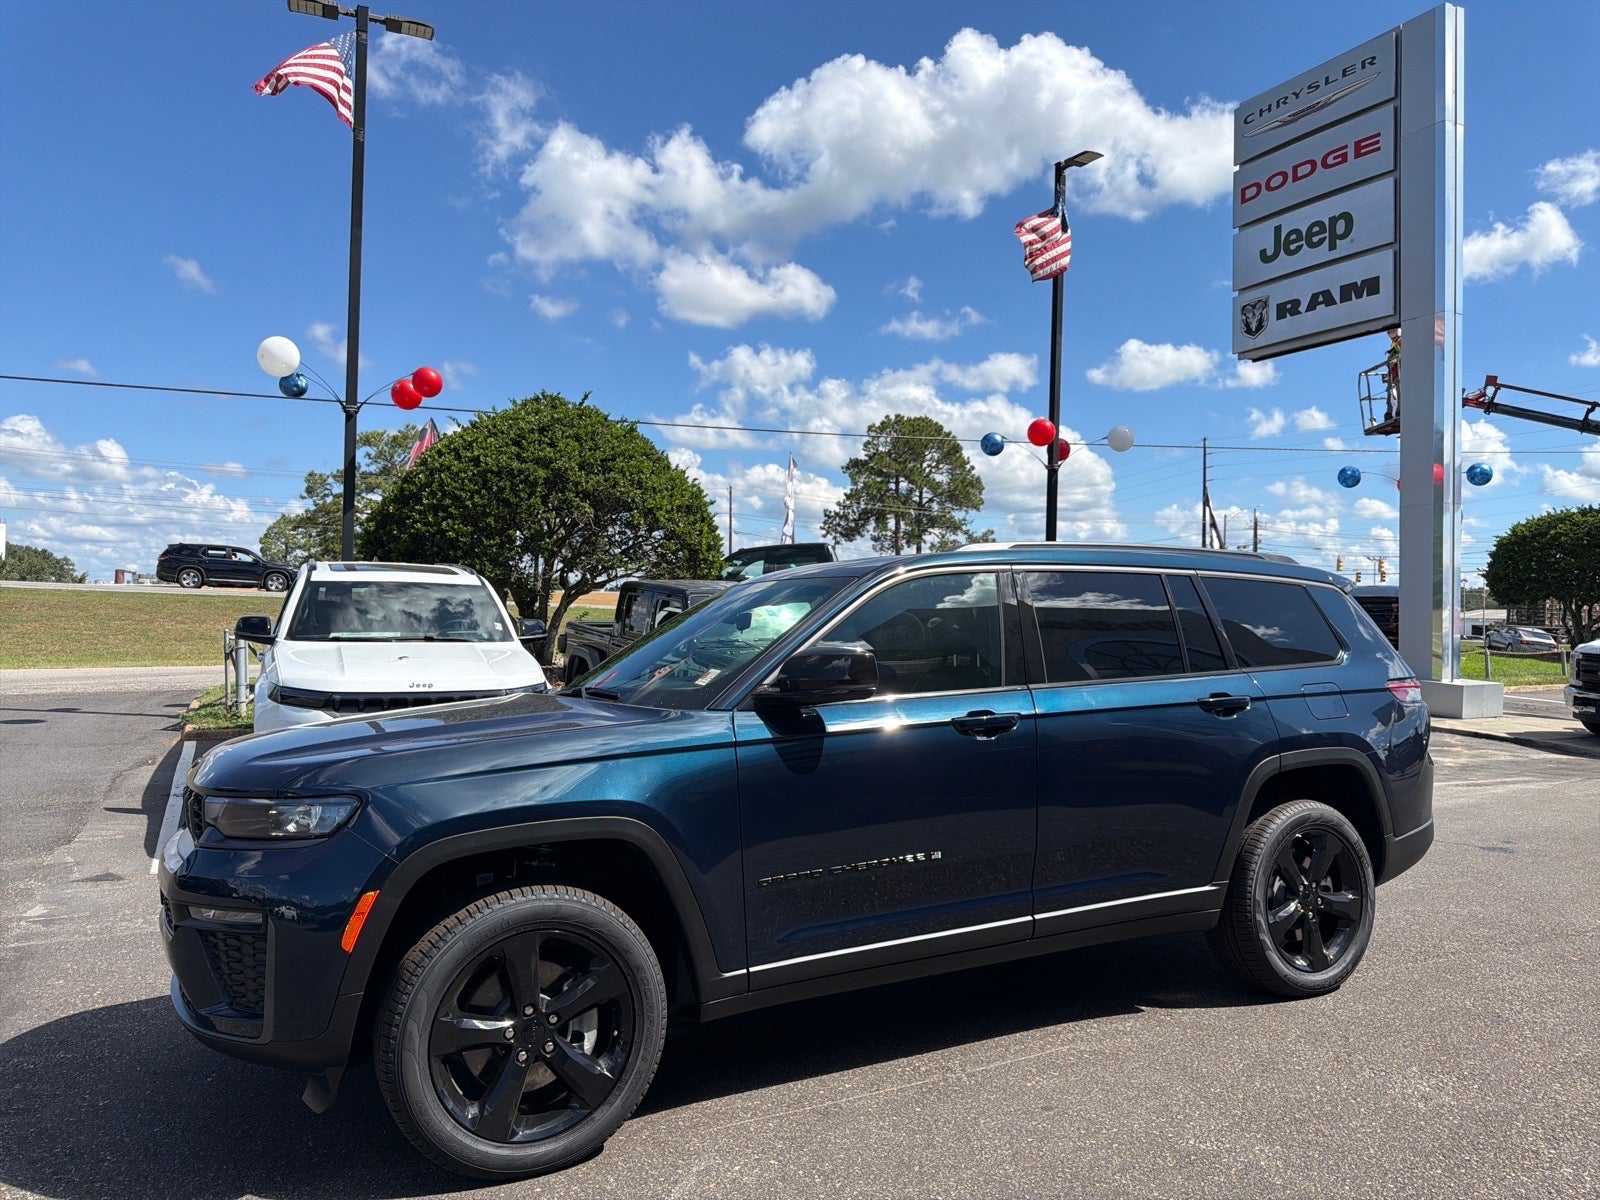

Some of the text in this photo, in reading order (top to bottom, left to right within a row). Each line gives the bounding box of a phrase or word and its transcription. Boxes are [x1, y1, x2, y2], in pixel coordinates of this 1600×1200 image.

[1243, 55, 1378, 126] CHRYSLER
[1240, 132, 1382, 205] DODGE
[1259, 210, 1354, 264] Jeep
[1275, 275, 1380, 321] RAM
[408, 681, 434, 689] Jeep
